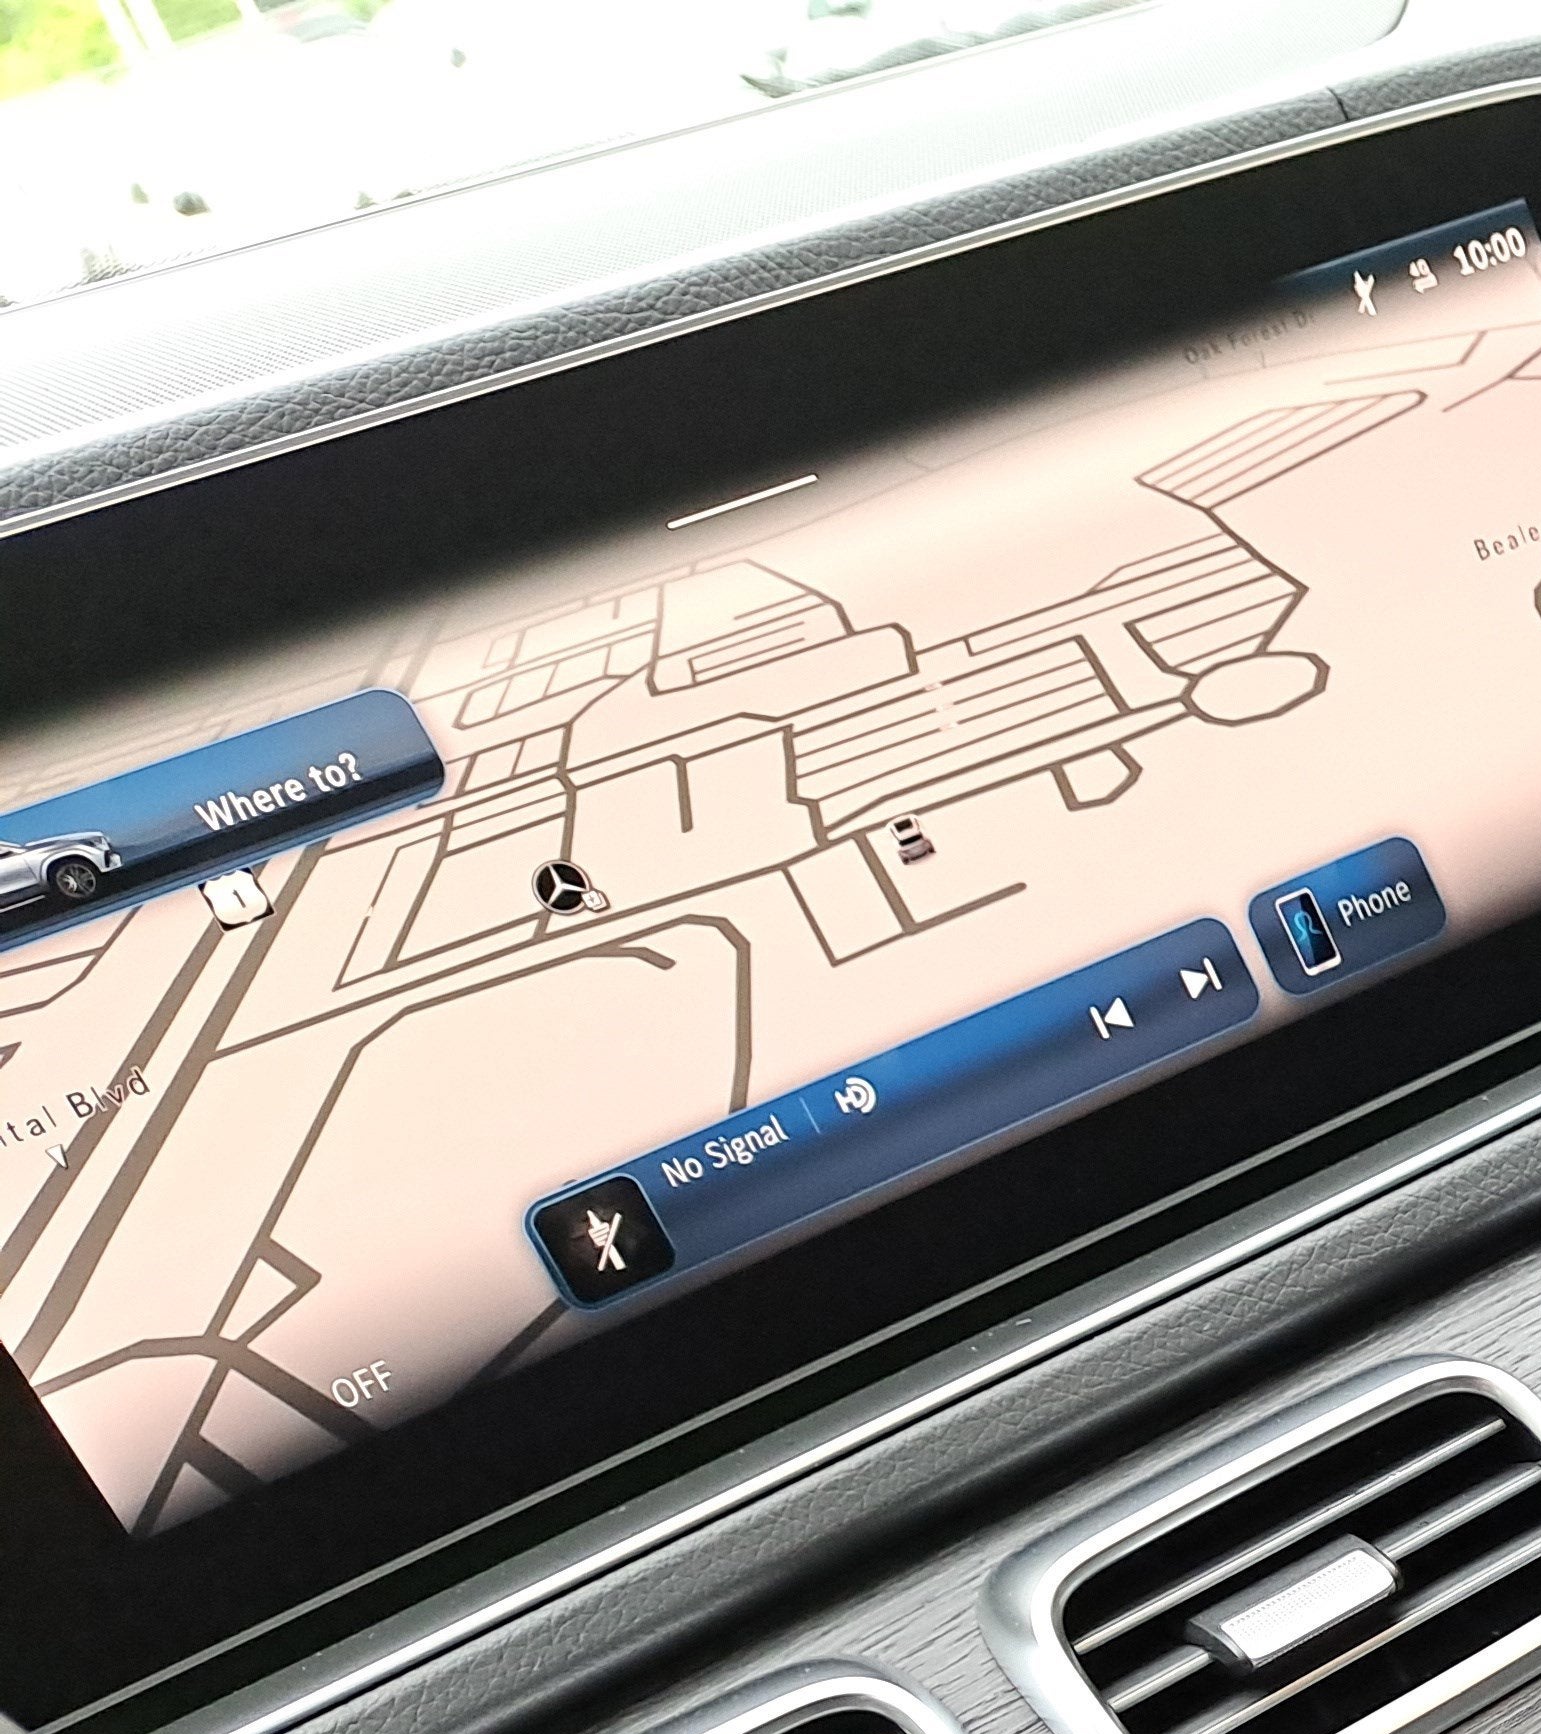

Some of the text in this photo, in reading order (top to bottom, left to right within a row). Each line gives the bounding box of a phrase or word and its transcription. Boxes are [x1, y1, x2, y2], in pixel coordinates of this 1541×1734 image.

[1453, 227, 1526, 276] 10:00
[1473, 525, 1540, 561] Beale
[194, 753, 362, 830] Where to?
[232, 888, 246, 908] 1
[1337, 880, 1412, 927] Phone
[66, 1068, 150, 1118] Blvd
[661, 1113, 790, 1188] No Signal
[331, 1359, 392, 1408] OFF
